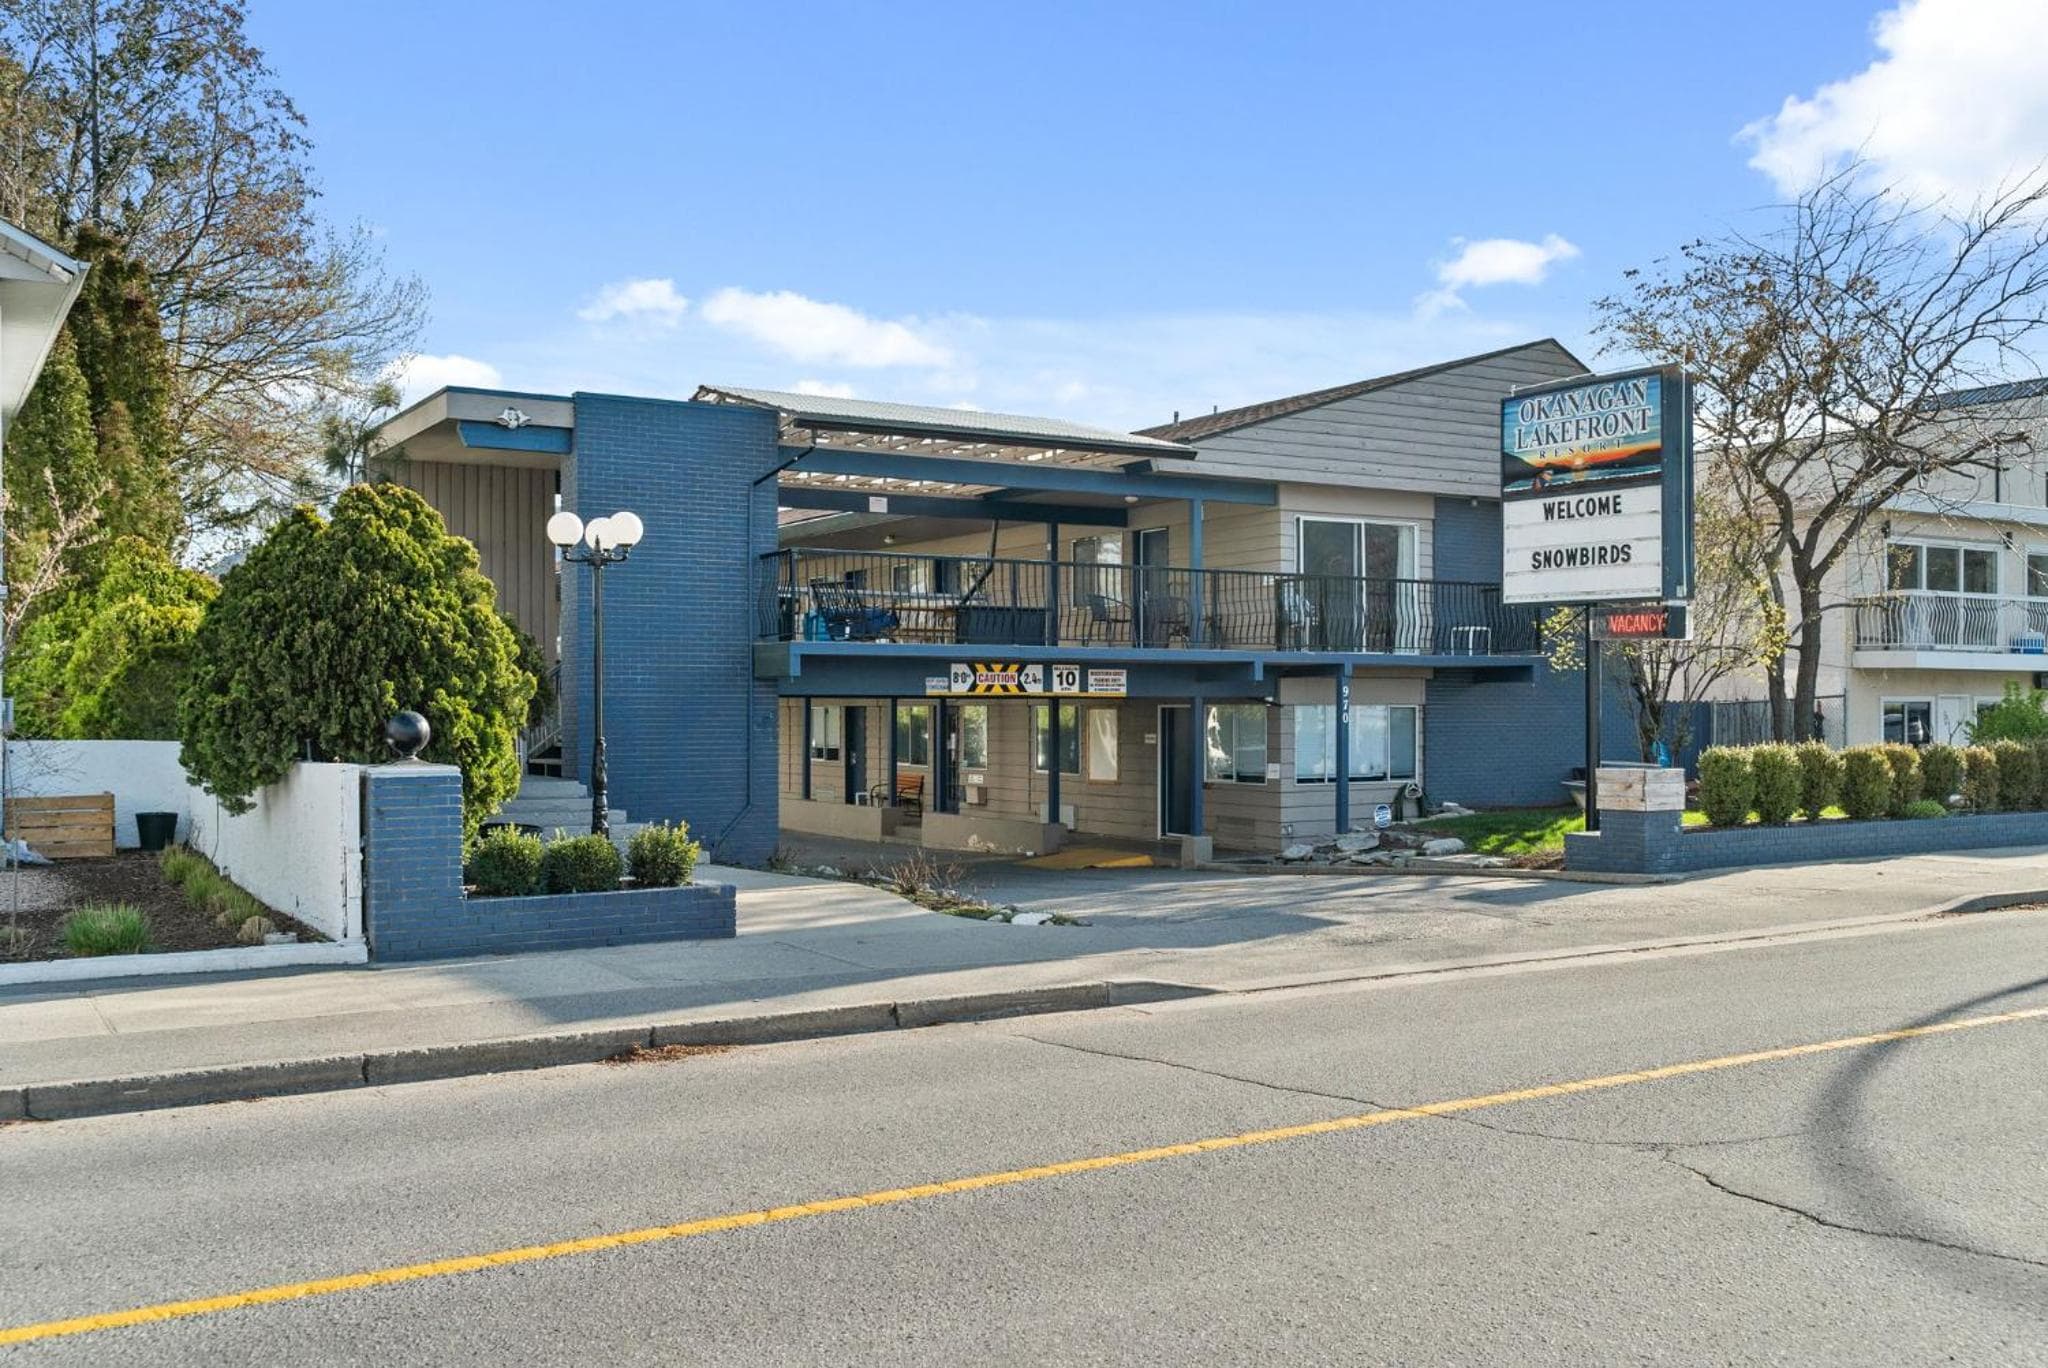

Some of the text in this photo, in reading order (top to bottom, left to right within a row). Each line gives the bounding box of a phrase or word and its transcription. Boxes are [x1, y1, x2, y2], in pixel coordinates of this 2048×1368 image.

[1519, 379, 1649, 424] OKANAGAN
[1515, 407, 1652, 450] LAKEFRONT
[1539, 439, 1625, 459] RESORT
[1543, 494, 1622, 521] WELCOME
[1531, 544, 1632, 570] SNOWBIRDS
[1609, 612, 1665, 632] VACANCY
[978, 673, 1016, 683] CAUTION
[1056, 671, 1076, 686] 10
